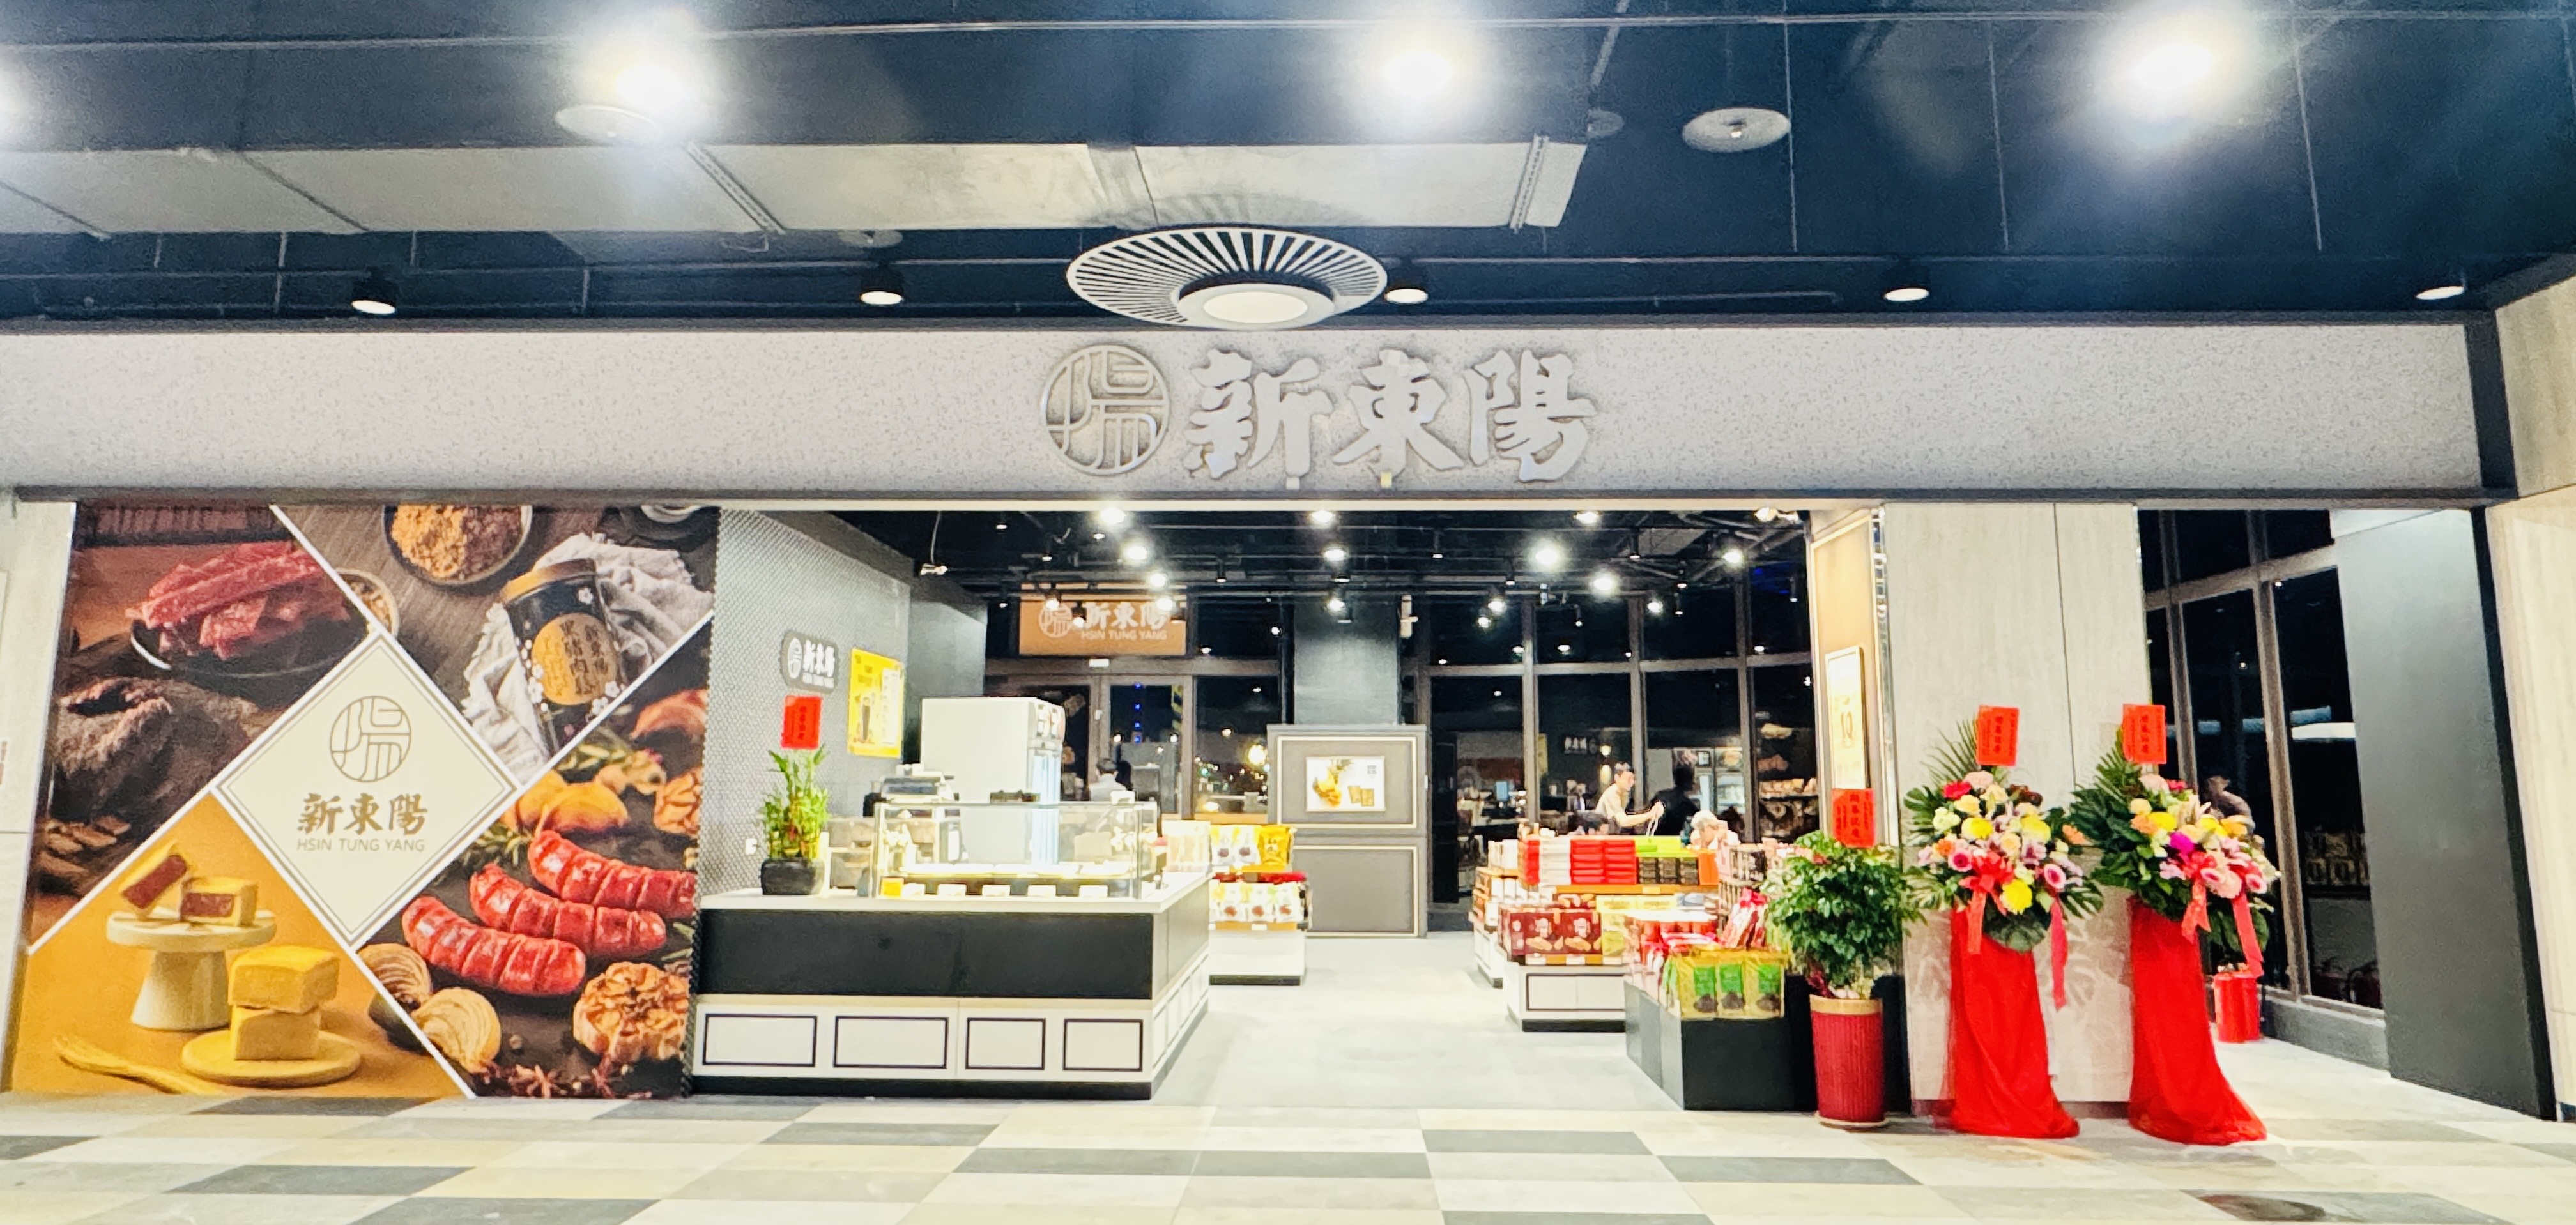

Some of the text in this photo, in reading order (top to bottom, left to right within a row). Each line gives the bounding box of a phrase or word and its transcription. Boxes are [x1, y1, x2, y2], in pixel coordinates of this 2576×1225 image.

[1184, 348, 1598, 483] 新東陽
[1081, 630, 1168, 640] HSIN TUNG YANG
[297, 792, 428, 835] 新東陽
[297, 838, 426, 852] HSIN TUNG YANG
